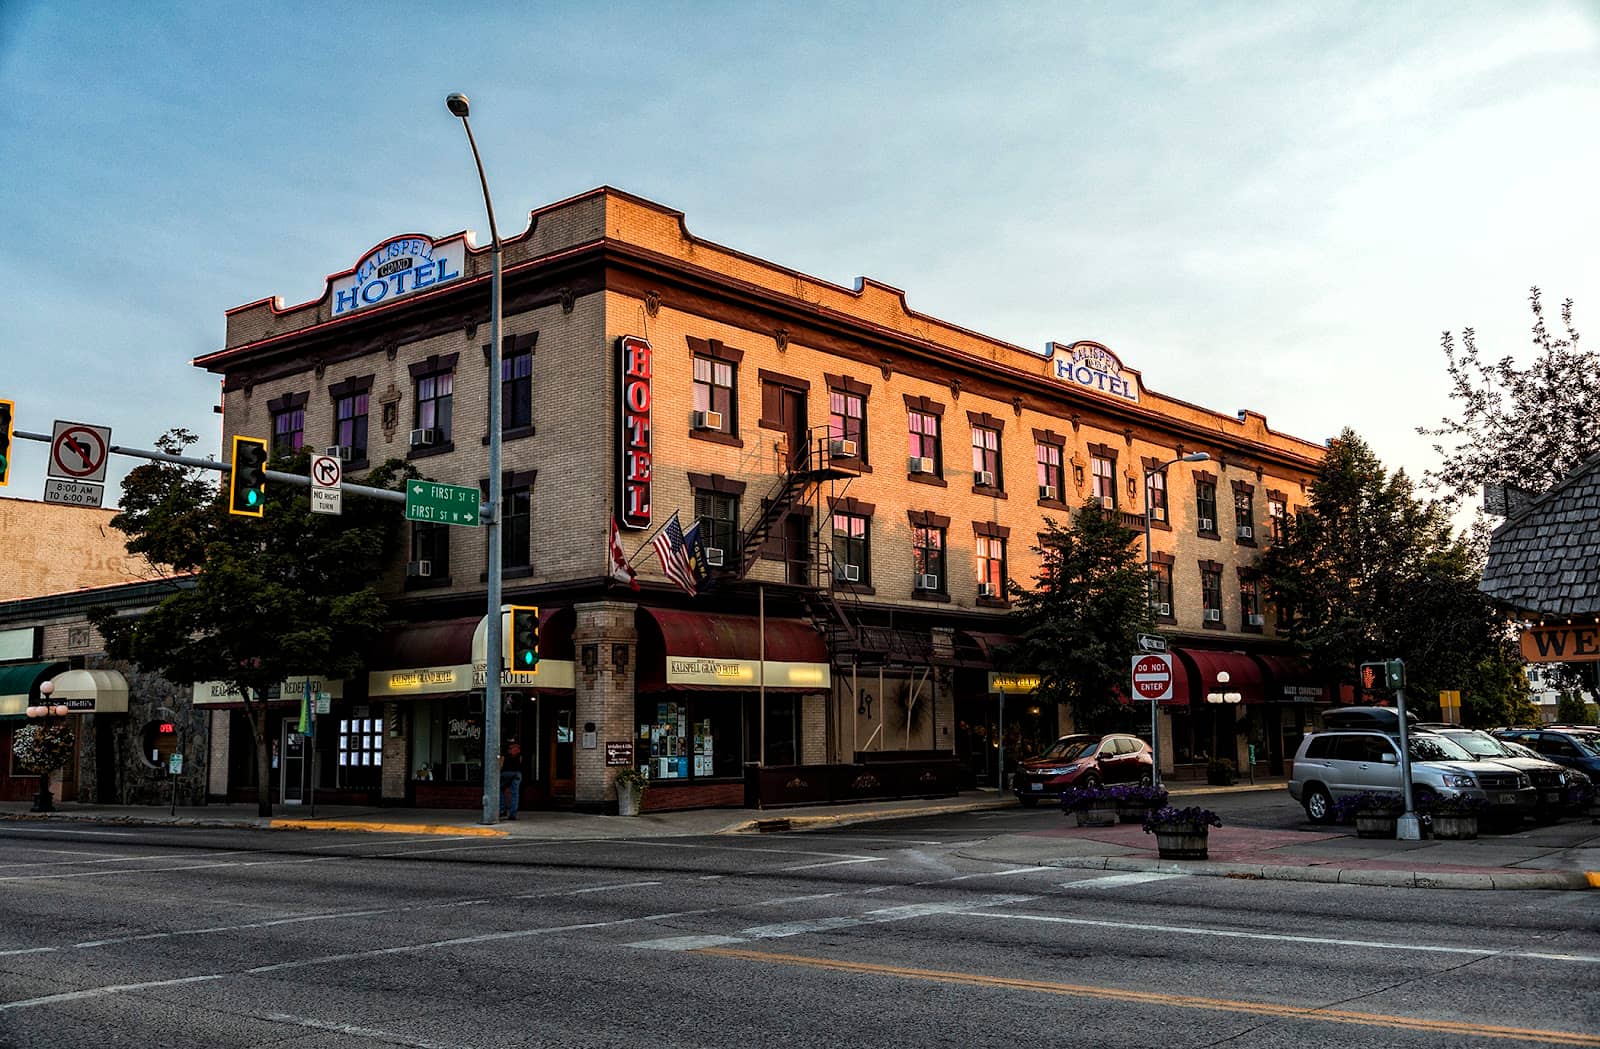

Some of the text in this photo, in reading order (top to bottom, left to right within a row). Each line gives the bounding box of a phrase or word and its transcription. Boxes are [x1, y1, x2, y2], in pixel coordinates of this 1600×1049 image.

[356, 239, 434, 286] KALISPELL
[380, 258, 410, 277] GRAND
[335, 258, 459, 313] HOTEL
[1056, 359, 1136, 401] HOTEL
[626, 345, 652, 518] HOTEL
[56, 483, 93, 495] 8:00 AM
[313, 491, 339, 501] NO RIGHT
[431, 487, 475, 503] FIRST ST E
[50, 492, 98, 504] TO 6:00 PM
[319, 502, 334, 510] TURN
[411, 505, 458, 521] FIRST ST W
[671, 661, 740, 675] KALISPELL GRAND HOTEL
[1137, 663, 1166, 672] DO NOT
[1140, 682, 1163, 691] ENTER
